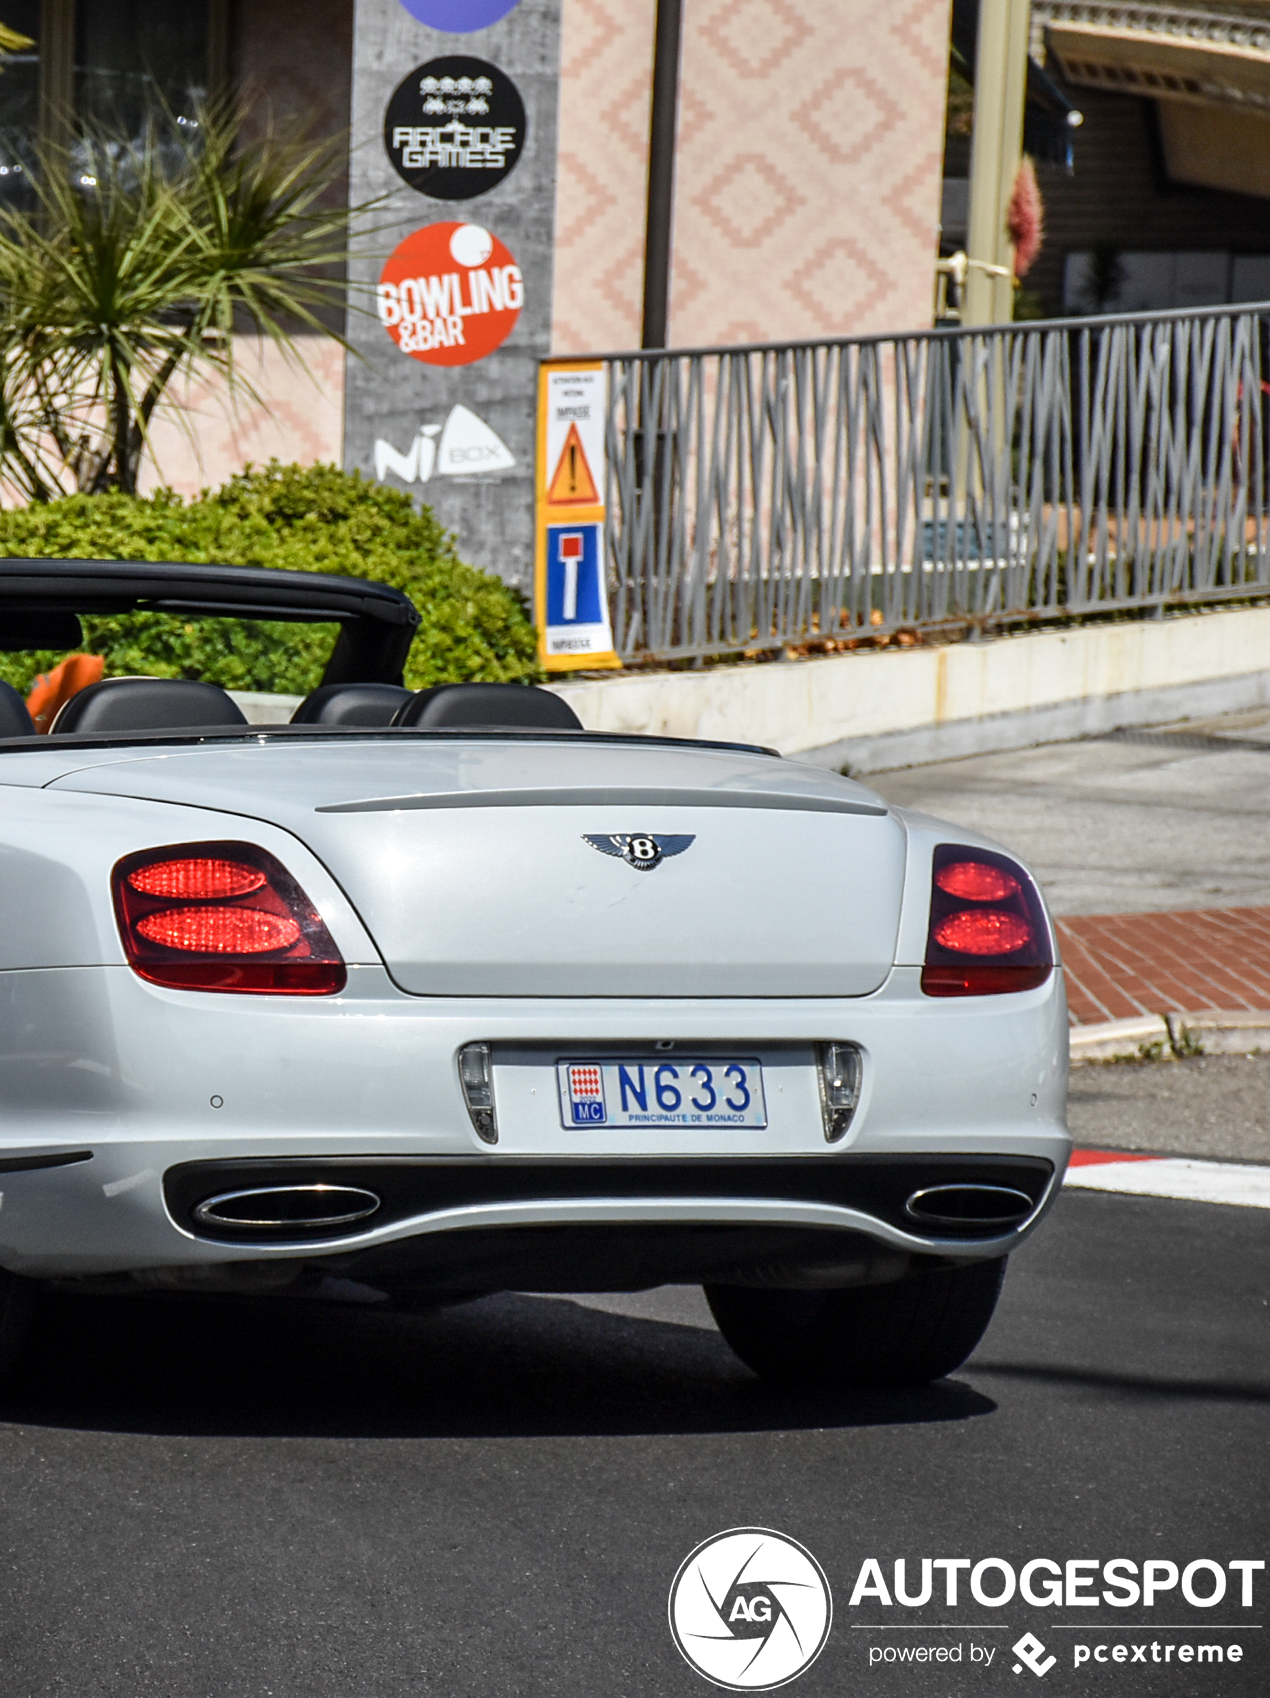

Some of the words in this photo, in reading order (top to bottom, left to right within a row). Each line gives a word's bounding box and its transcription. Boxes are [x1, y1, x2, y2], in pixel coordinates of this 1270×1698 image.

[393, 126, 517, 149] ARCADE
[402, 147, 506, 168] GAMES
[377, 264, 524, 327] BOWLING
[398, 315, 466, 354] &BAR
[448, 444, 501, 464] BOX
[617, 1063, 751, 1113] N633
[578, 1103, 600, 1120] MC
[628, 1113, 688, 1124] PRINCIPAUTE
[690, 1113, 703, 1123] DE
[706, 1113, 746, 1123] MONACO
